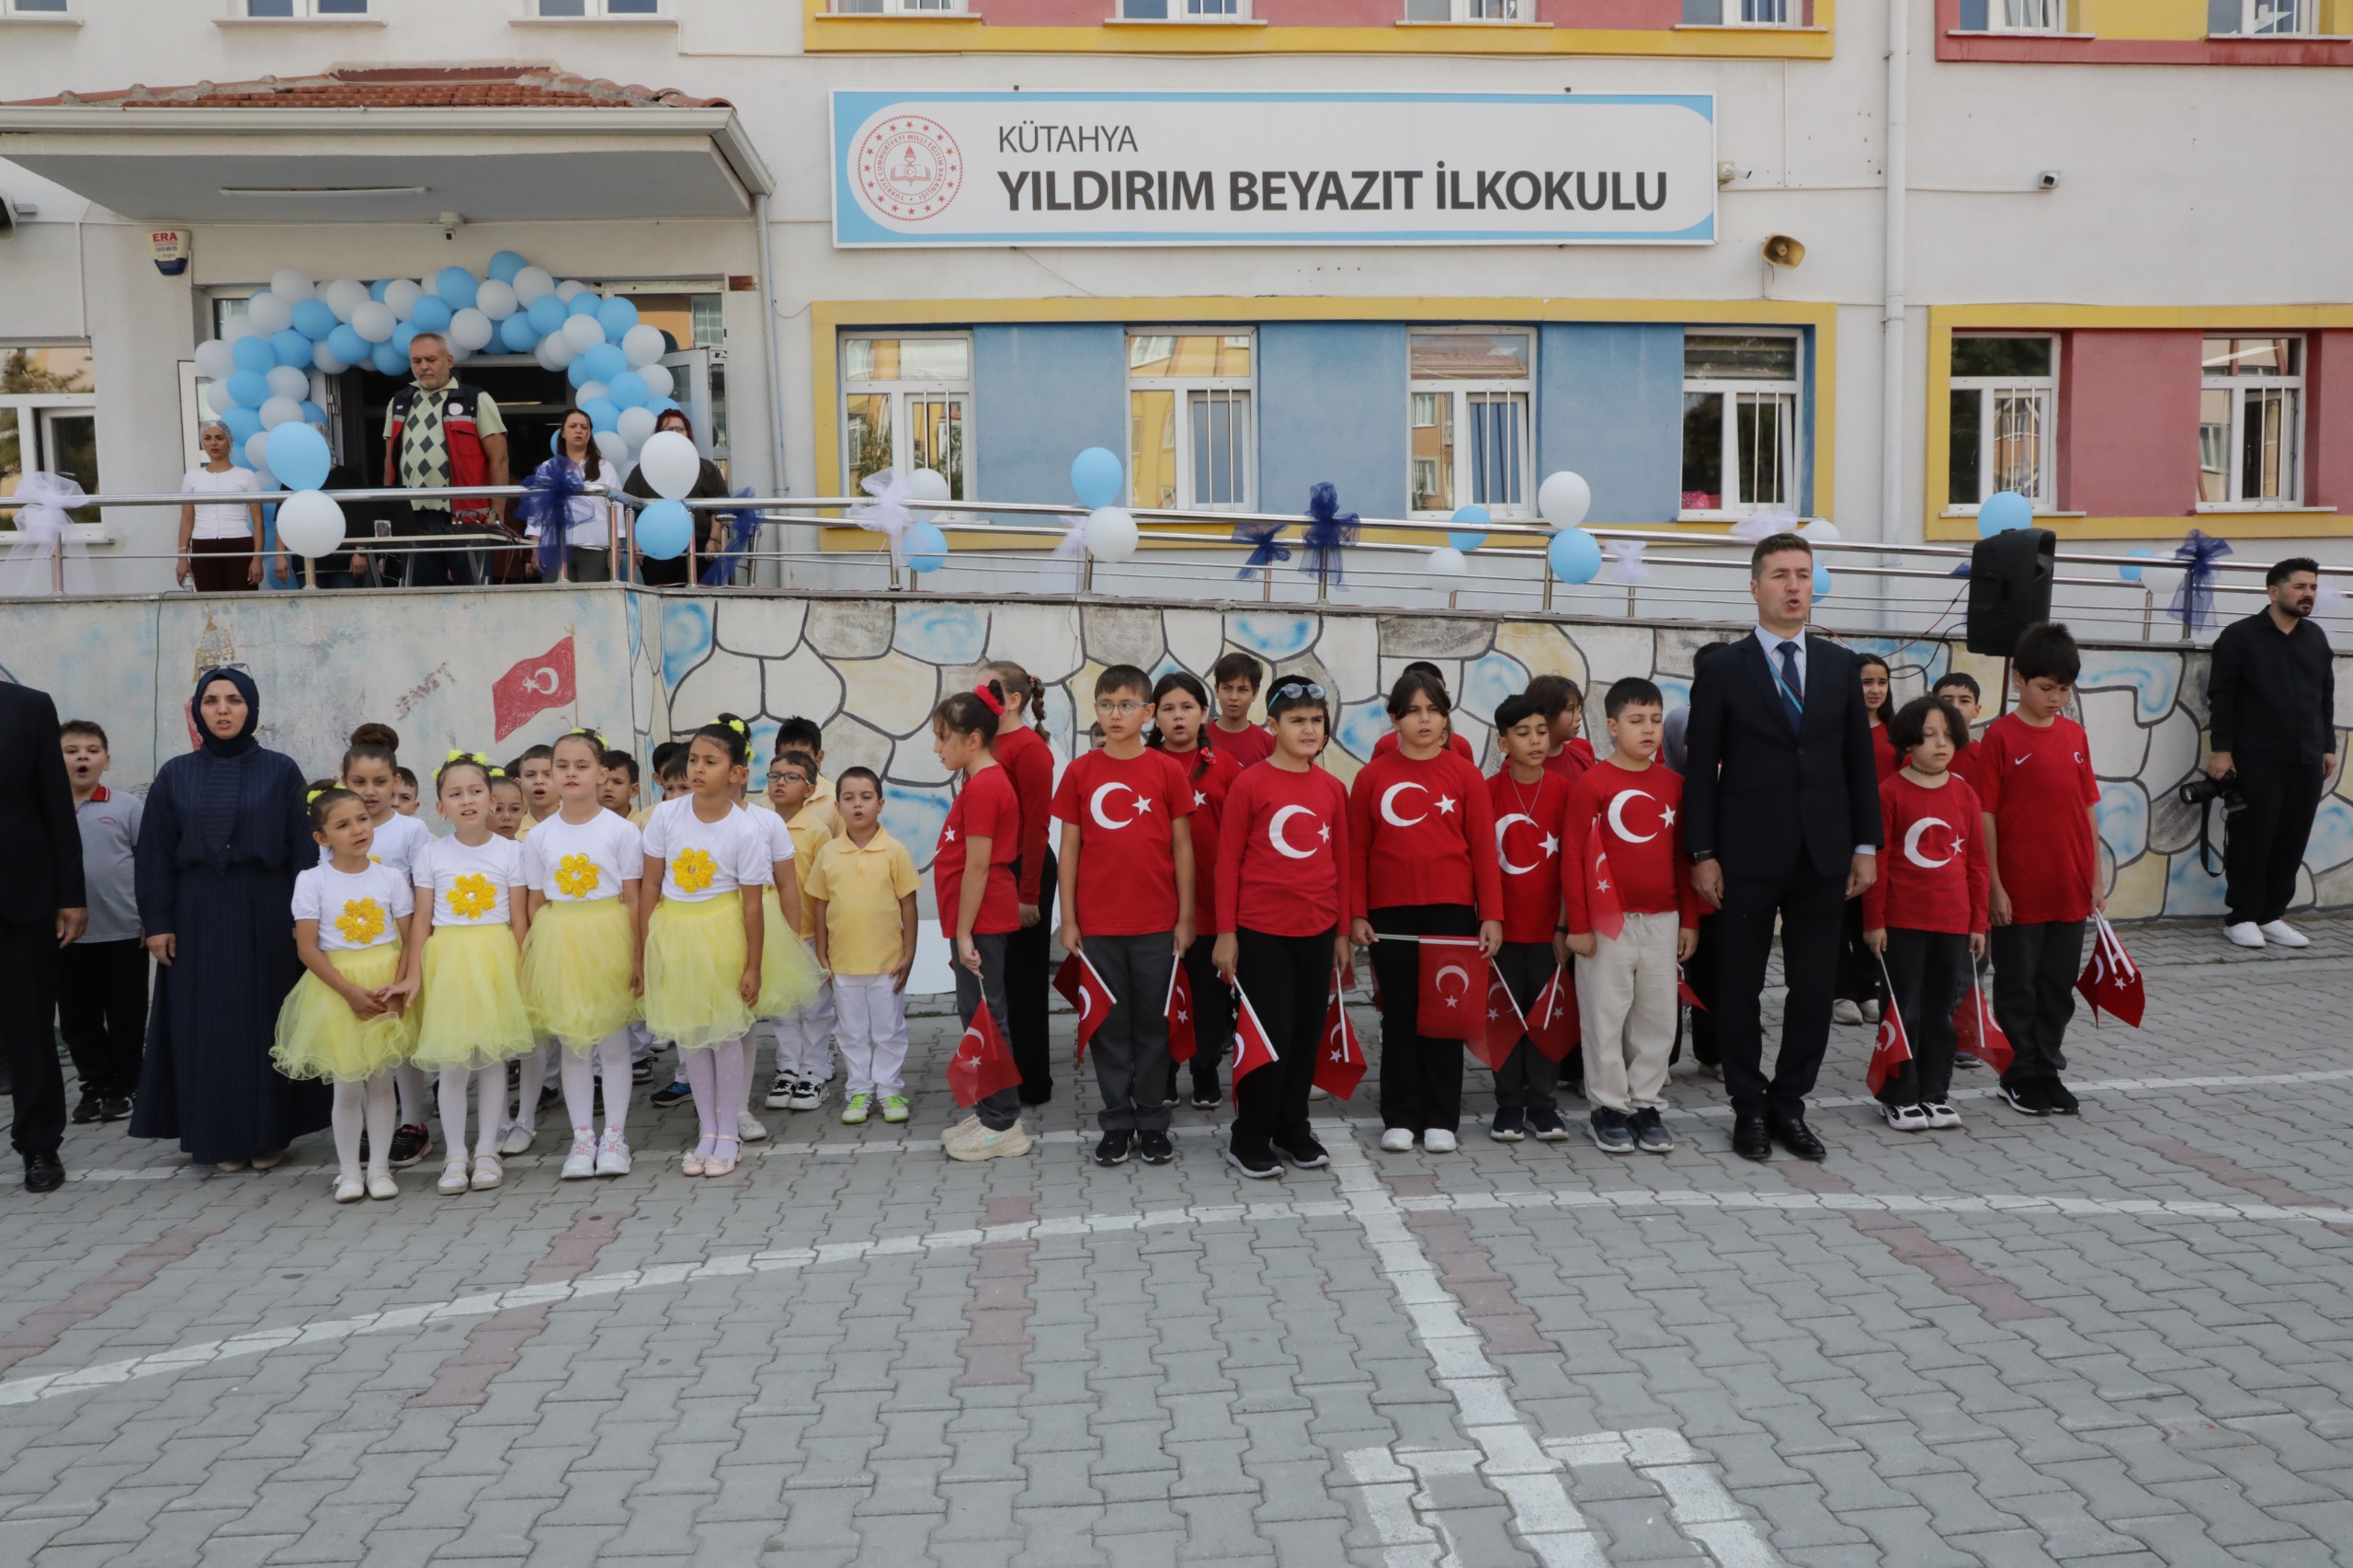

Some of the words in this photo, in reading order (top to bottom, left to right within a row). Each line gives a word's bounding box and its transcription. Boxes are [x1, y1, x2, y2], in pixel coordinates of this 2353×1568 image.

[999, 120, 1139, 153] KÜTAHYA
[997, 170, 1215, 211] YILDIRIM
[1229, 170, 1424, 211] BEYAZIT
[1436, 160, 1667, 211] İLKOKULU
[153, 232, 177, 243] ERA
